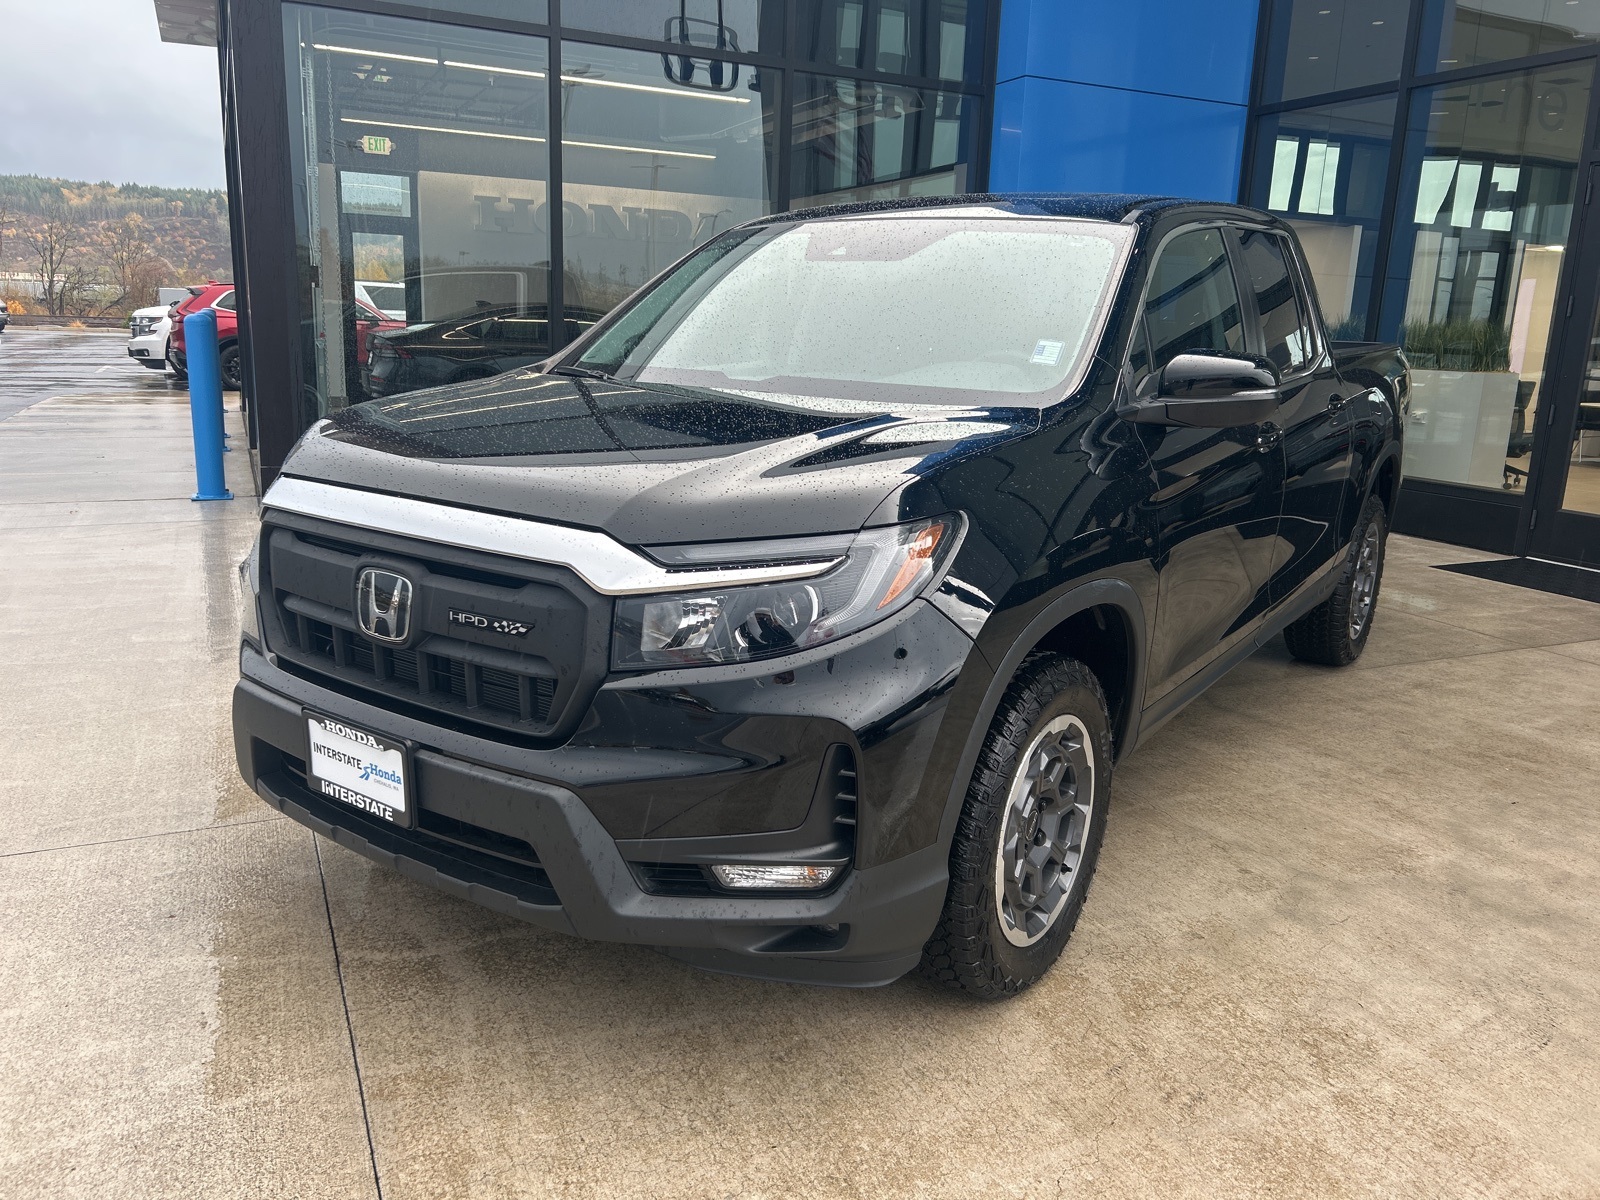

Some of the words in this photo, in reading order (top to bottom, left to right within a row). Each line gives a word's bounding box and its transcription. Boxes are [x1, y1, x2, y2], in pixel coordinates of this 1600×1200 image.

[368, 137, 386, 152] EXIT
[449, 611, 488, 627] HPD
[324, 719, 379, 748] HONDA
[313, 741, 362, 770] INTERSTATE
[369, 763, 402, 785] Honda
[321, 780, 393, 821] INTERSTATE
